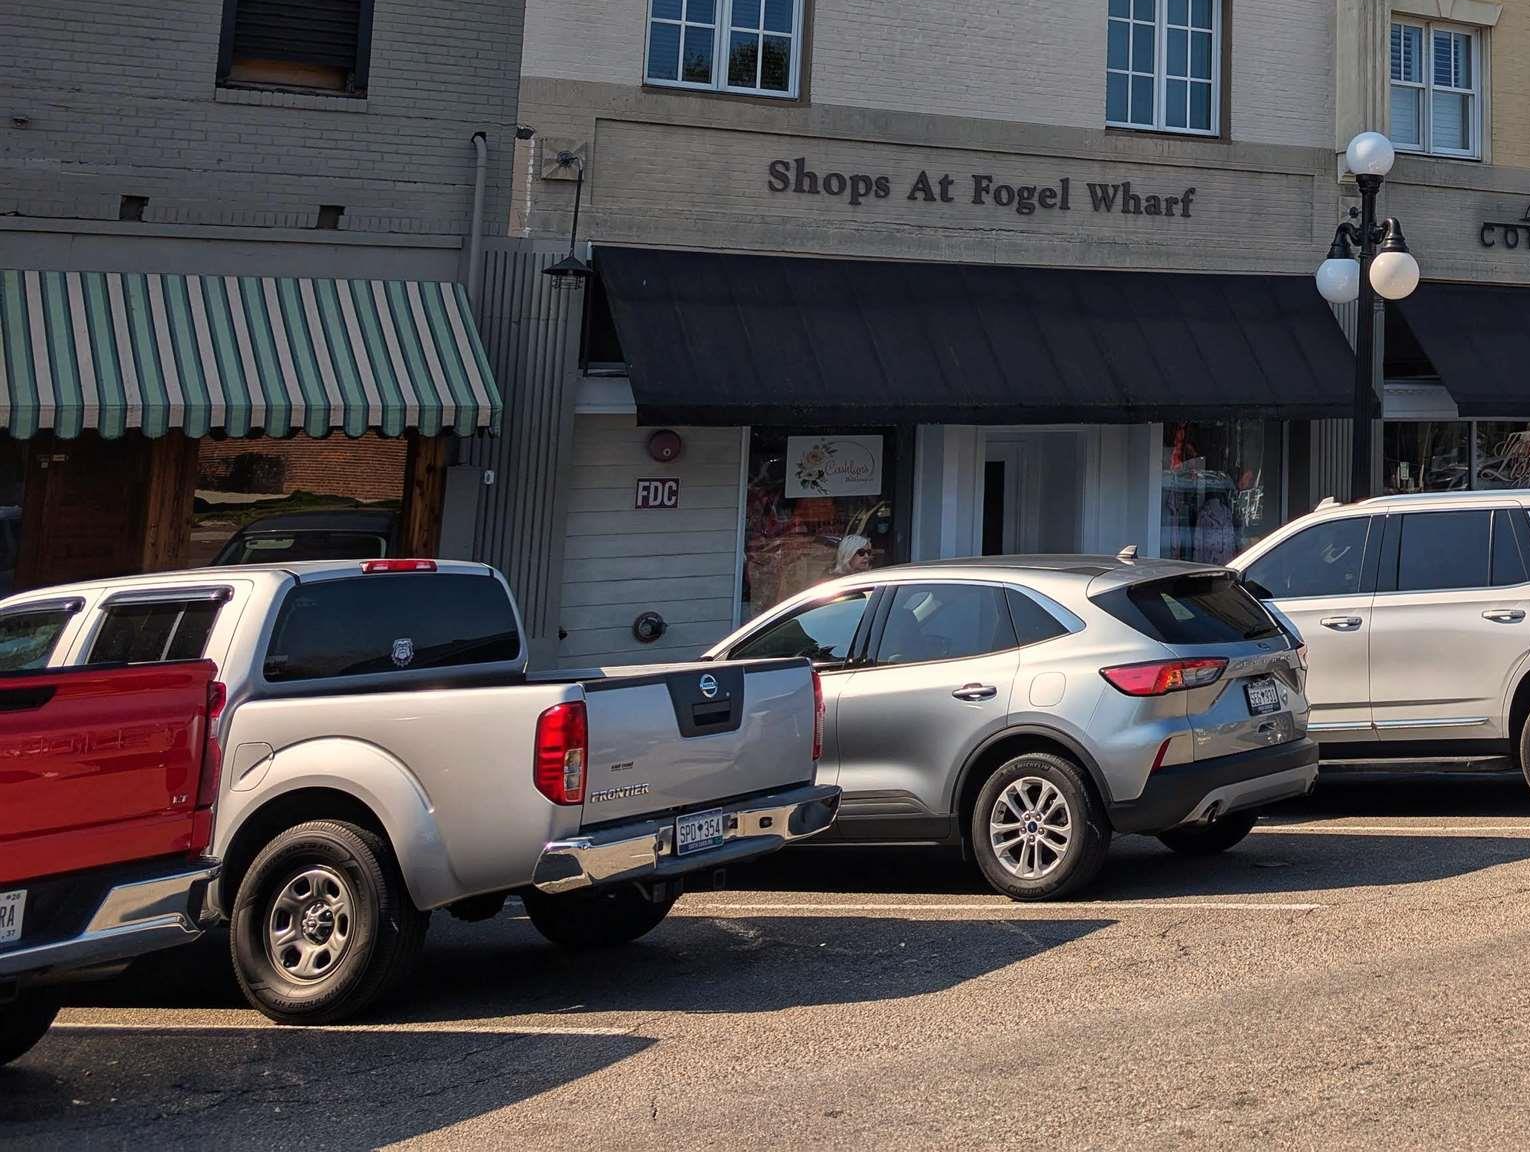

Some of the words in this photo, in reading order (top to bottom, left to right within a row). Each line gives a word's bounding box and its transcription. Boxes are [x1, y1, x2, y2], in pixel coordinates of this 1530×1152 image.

[768, 157, 891, 206] Shops
[907, 170, 955, 203] At
[971, 174, 1071, 216] Fogel
[1087, 181, 1197, 219] Wharf
[637, 481, 677, 506] FDC
[591, 783, 649, 803] FRONTIER
[704, 818, 721, 838] 354
